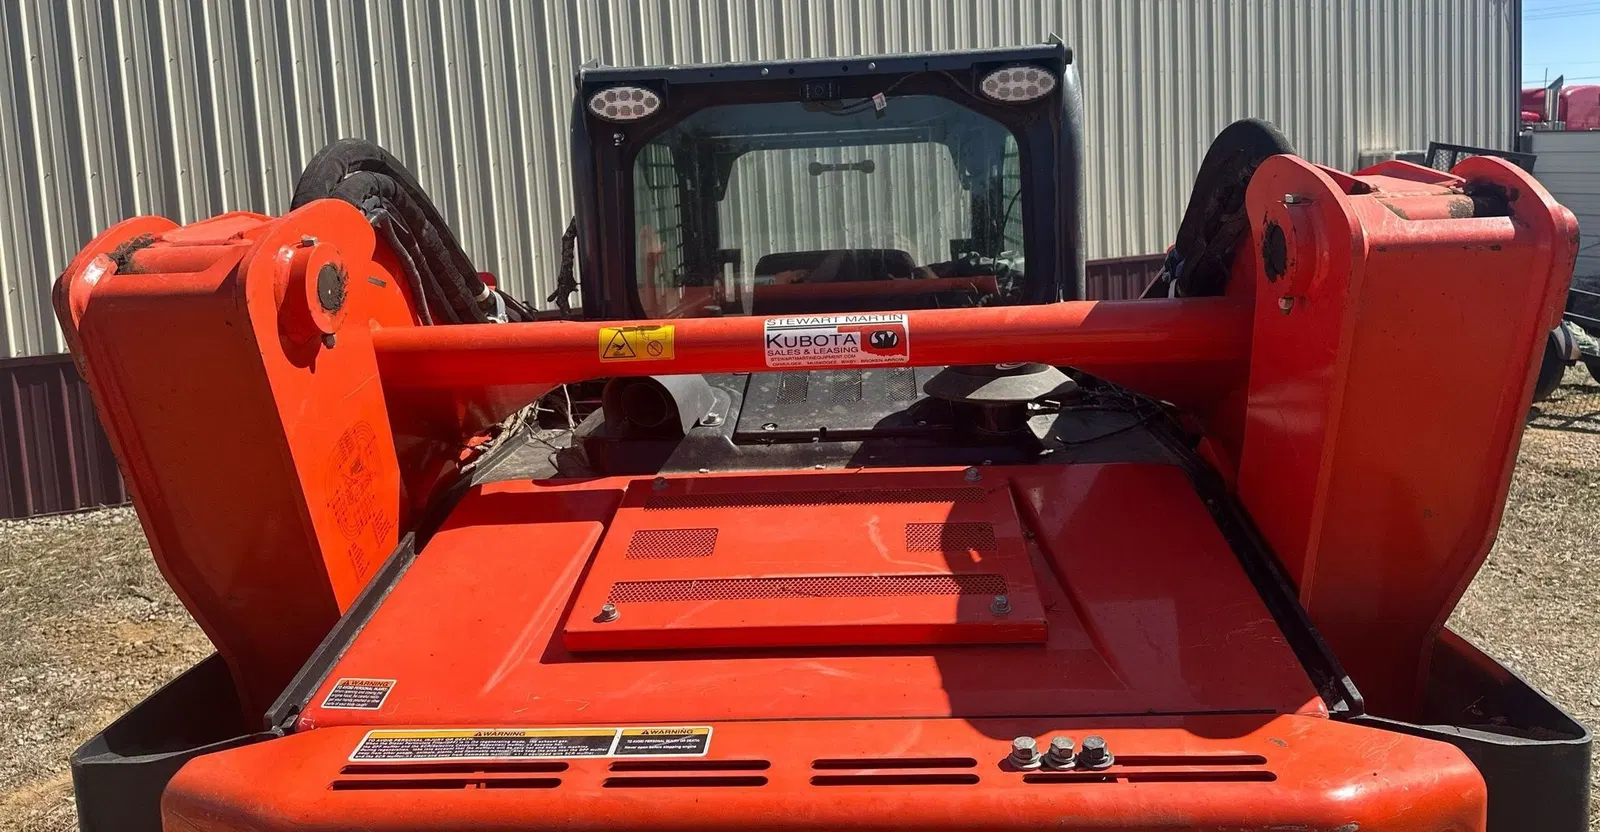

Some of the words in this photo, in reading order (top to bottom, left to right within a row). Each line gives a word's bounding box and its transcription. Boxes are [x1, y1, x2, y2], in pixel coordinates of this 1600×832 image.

[766, 316, 838, 326] STEWART
[846, 314, 903, 322] MARTIN
[766, 333, 857, 348] KUBOTA
